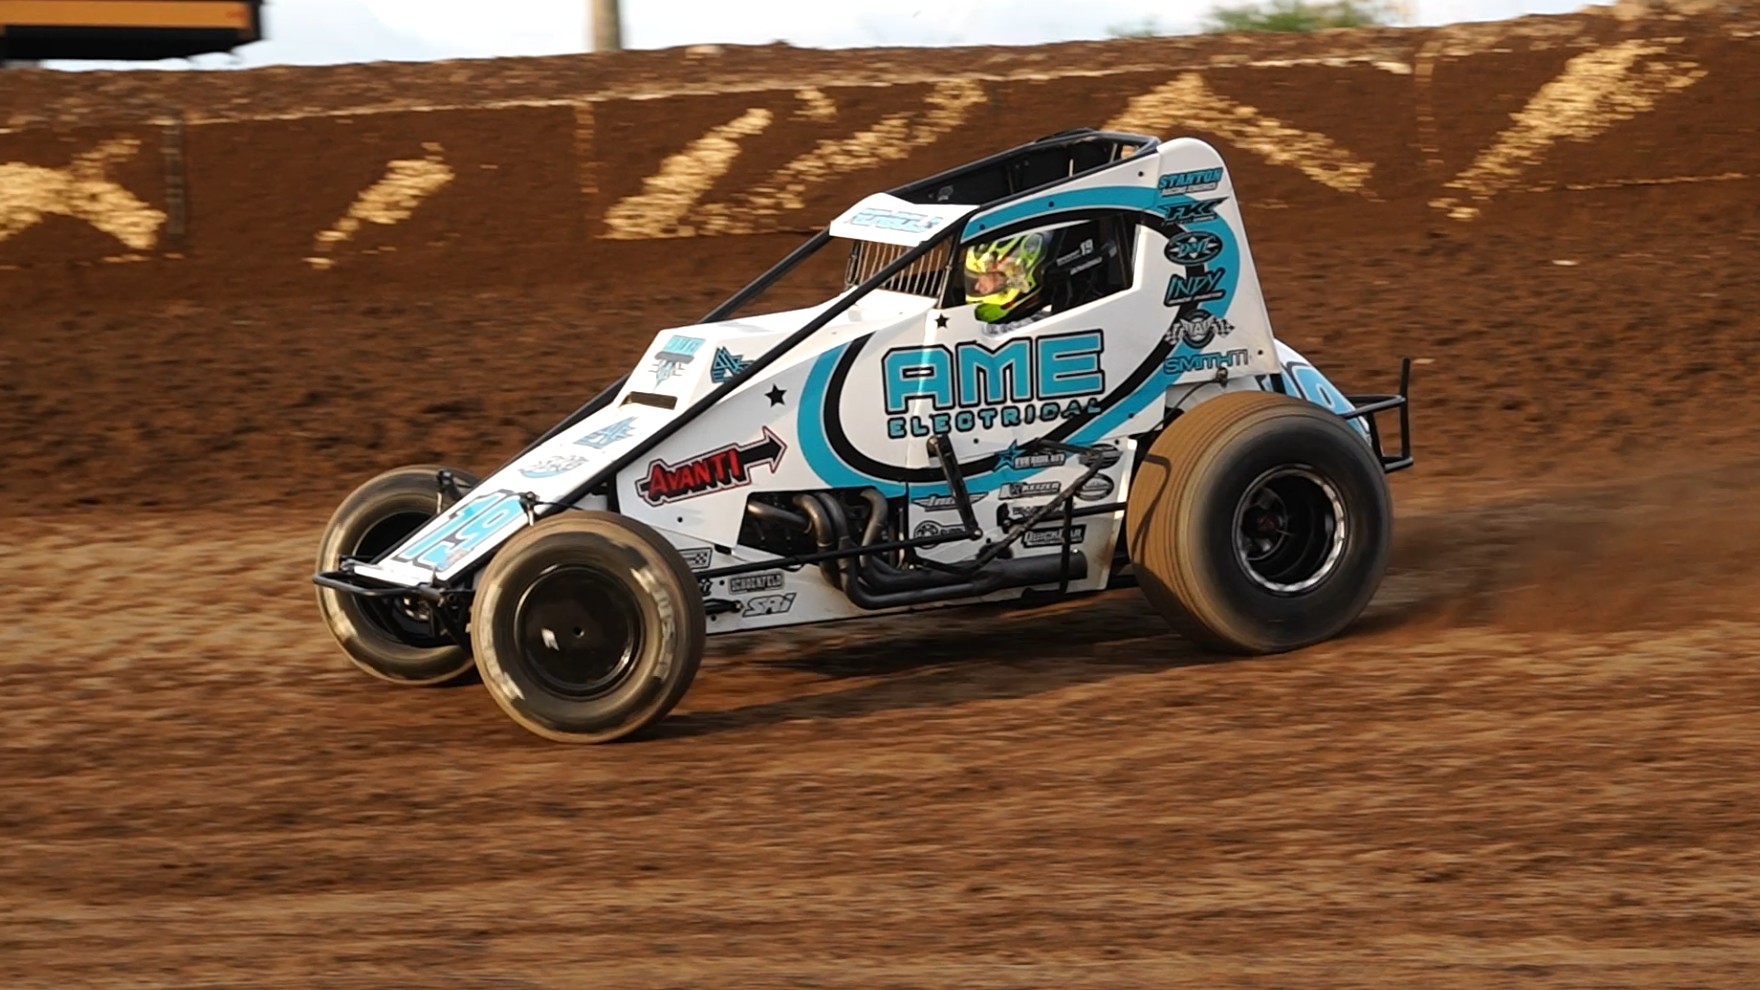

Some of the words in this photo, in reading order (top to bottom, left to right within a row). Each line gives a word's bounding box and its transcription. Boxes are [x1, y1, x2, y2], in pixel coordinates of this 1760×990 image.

[1159, 167, 1223, 189] STANTON
[1168, 270, 1222, 299] INDY
[882, 329, 1105, 414] AME
[887, 398, 1102, 438] ELECTRICAL
[391, 488, 530, 572] 19
